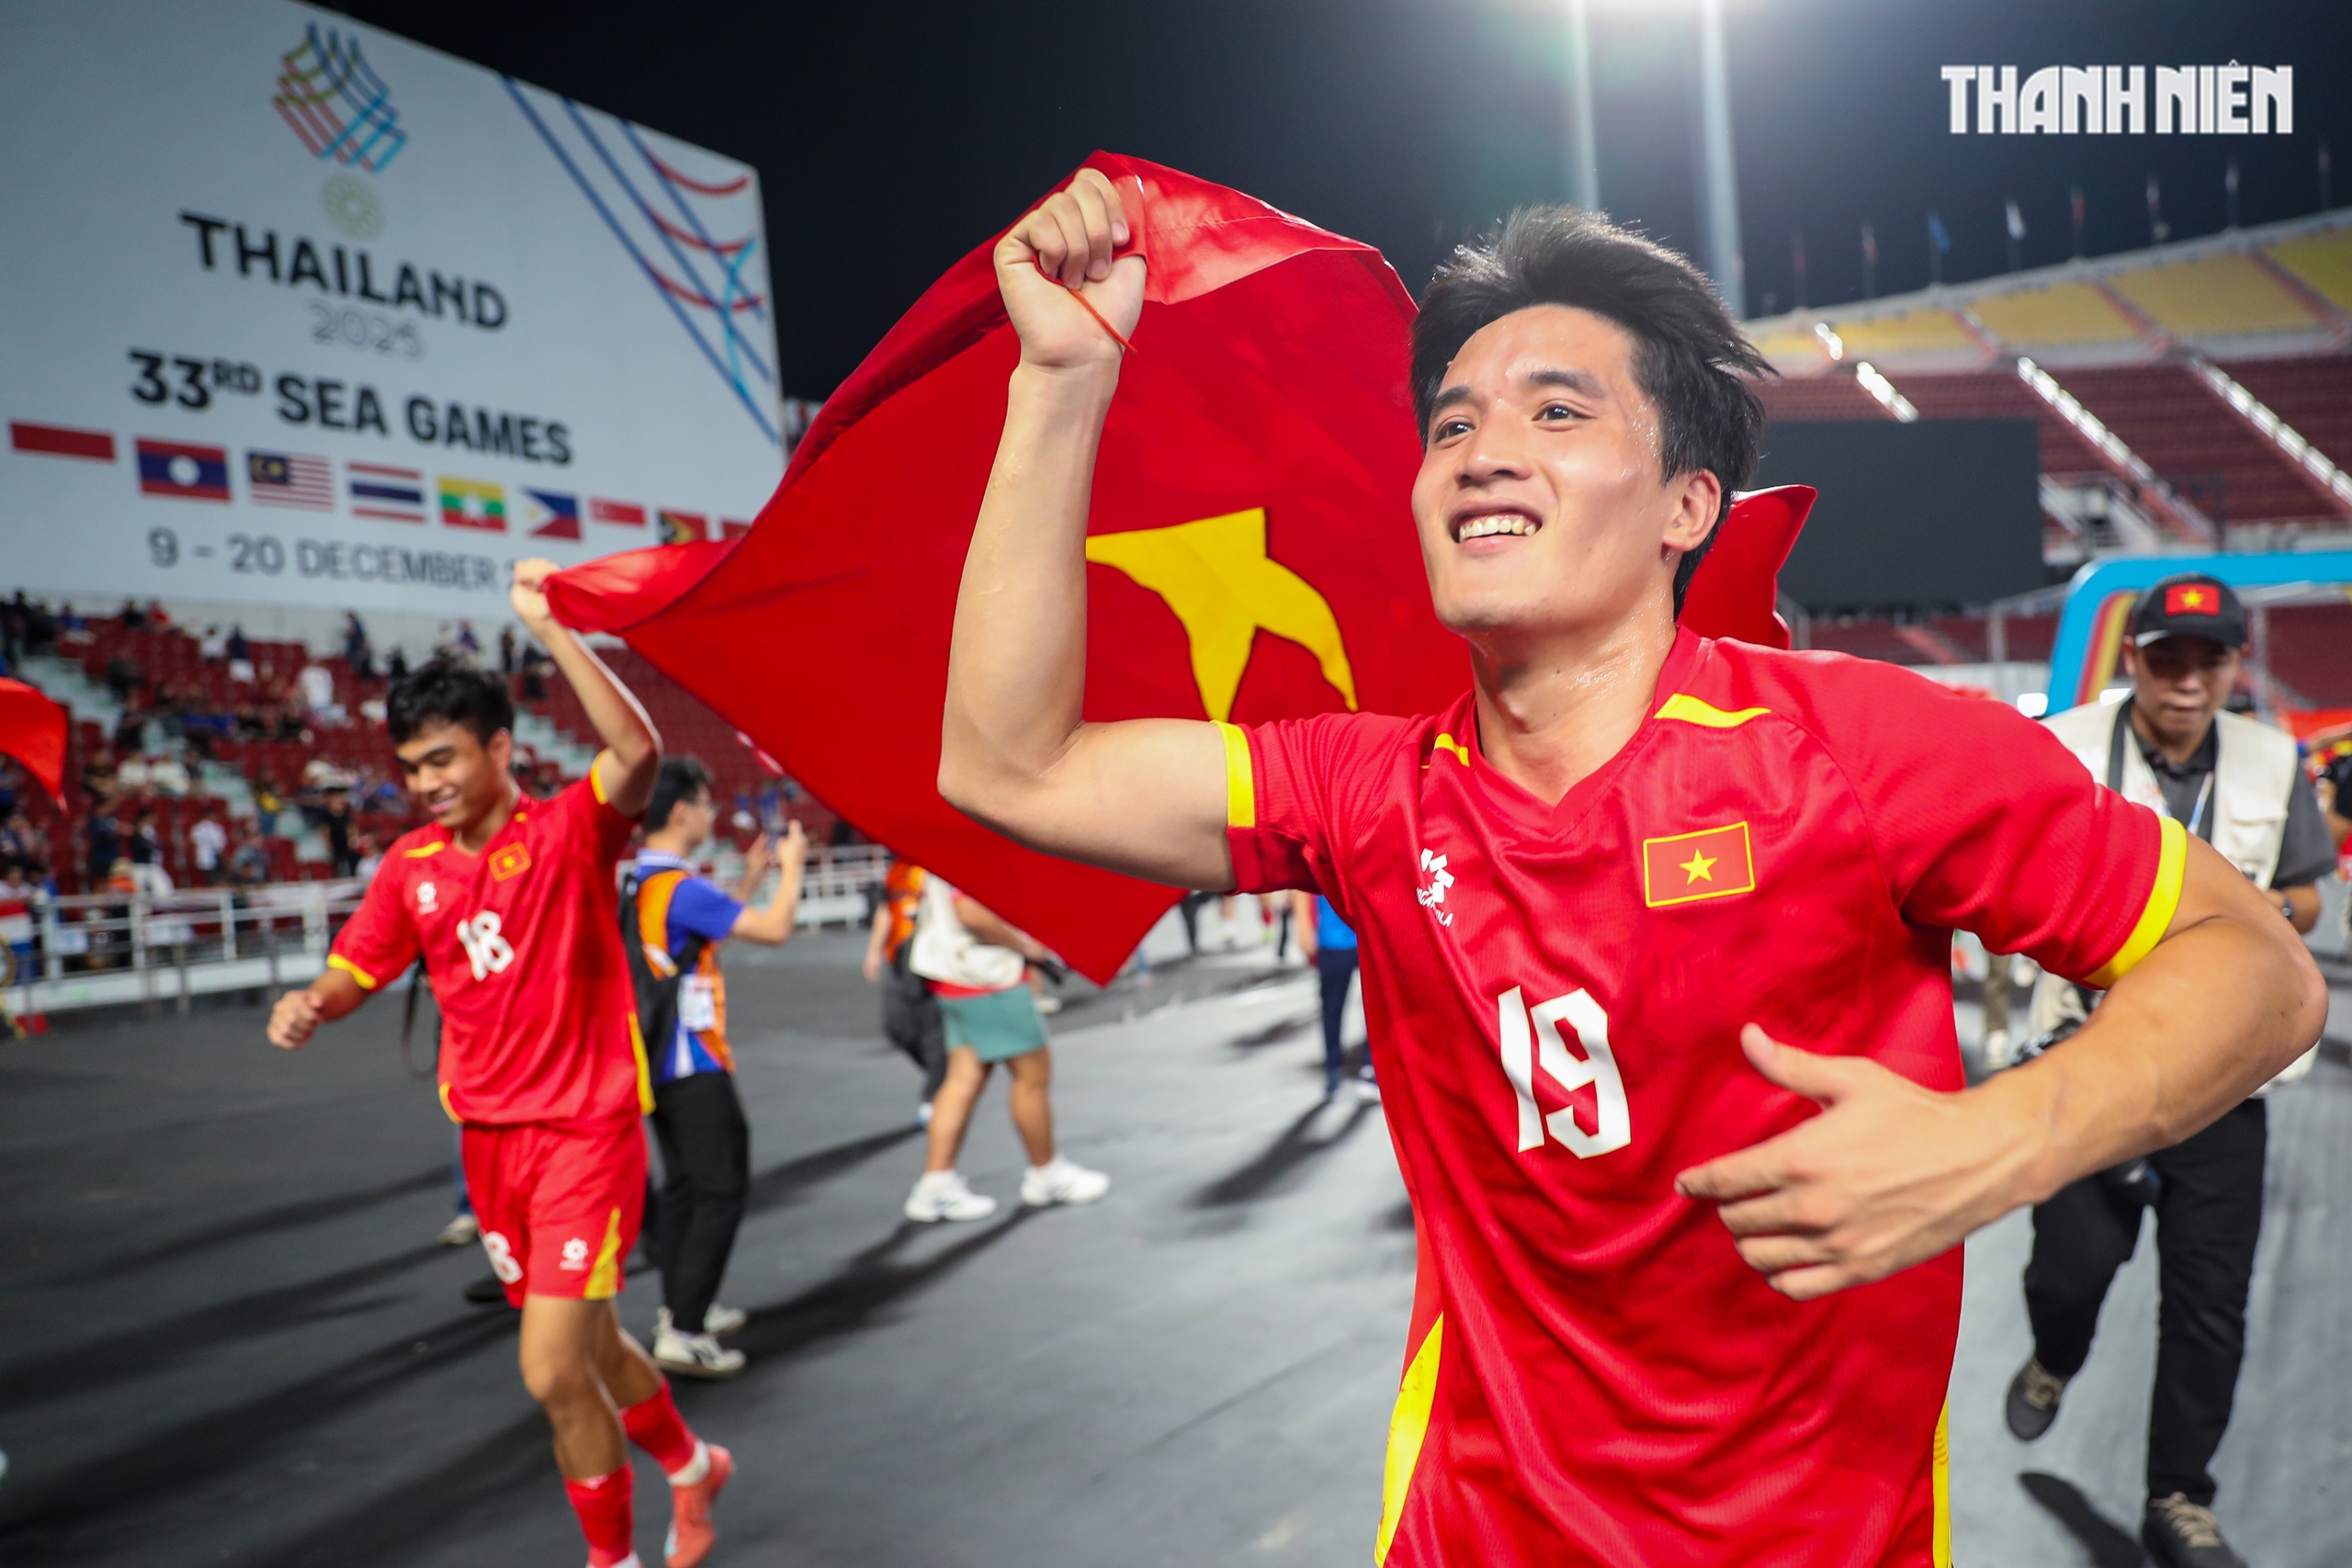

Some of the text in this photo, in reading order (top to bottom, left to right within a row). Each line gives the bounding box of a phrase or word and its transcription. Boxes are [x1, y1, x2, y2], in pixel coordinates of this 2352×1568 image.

[179, 211, 507, 331] THAILAND
[309, 299, 425, 361] 2025
[129, 348, 573, 466] 33RD SEA GAMES
[148, 526, 179, 569] 9
[226, 532, 286, 576] 20
[297, 537, 498, 592] DECEMBER
[457, 909, 514, 982] 18
[1498, 985, 1632, 1160] 19
